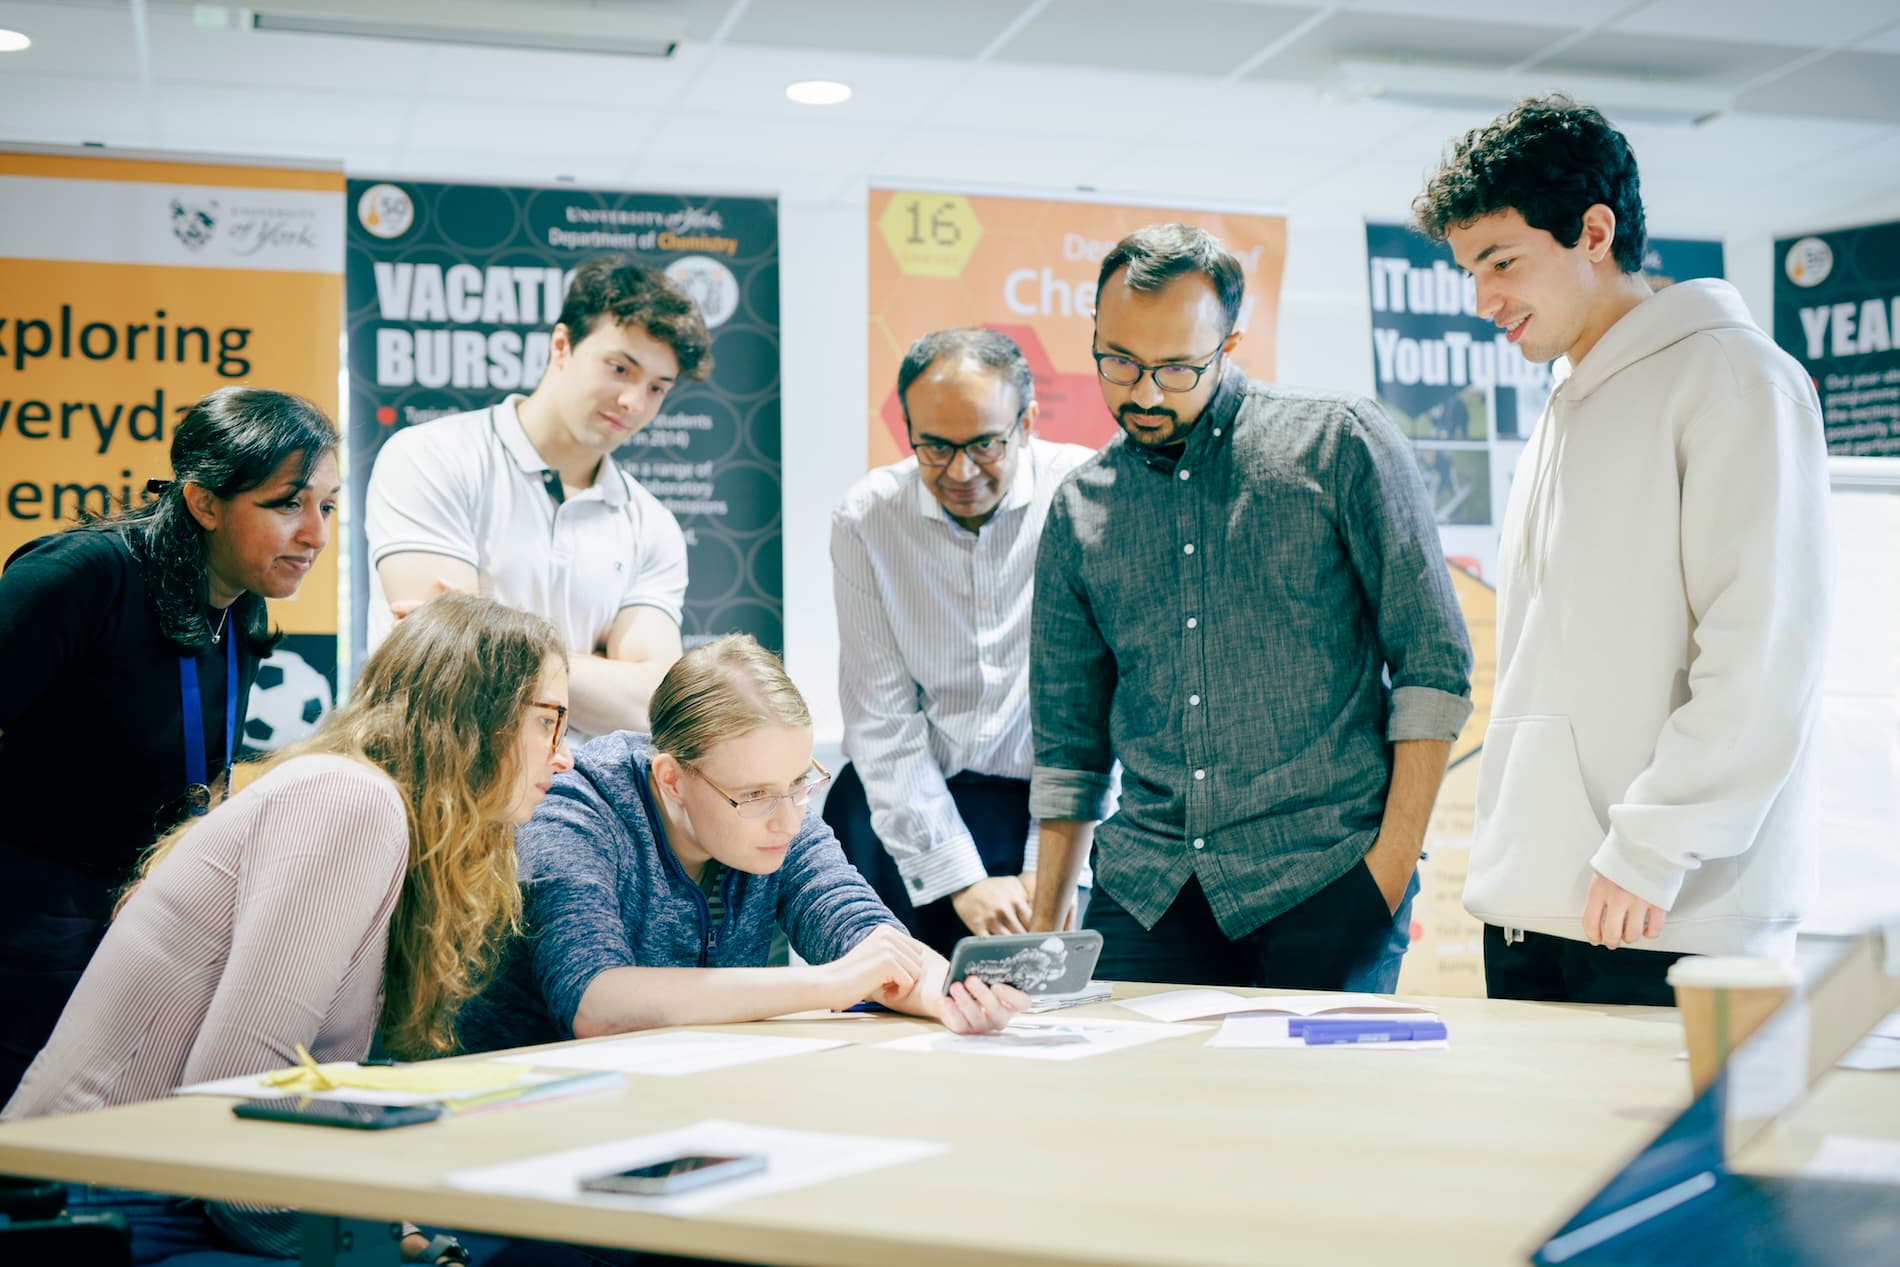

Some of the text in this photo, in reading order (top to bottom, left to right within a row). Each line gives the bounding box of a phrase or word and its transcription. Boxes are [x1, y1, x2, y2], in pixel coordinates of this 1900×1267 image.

[548, 226, 739, 257] Department of Chemistry
[904, 199, 963, 246] 16
[374, 262, 578, 325] VACATI
[0, 303, 253, 379] ploring
[0, 389, 190, 454] eryd
